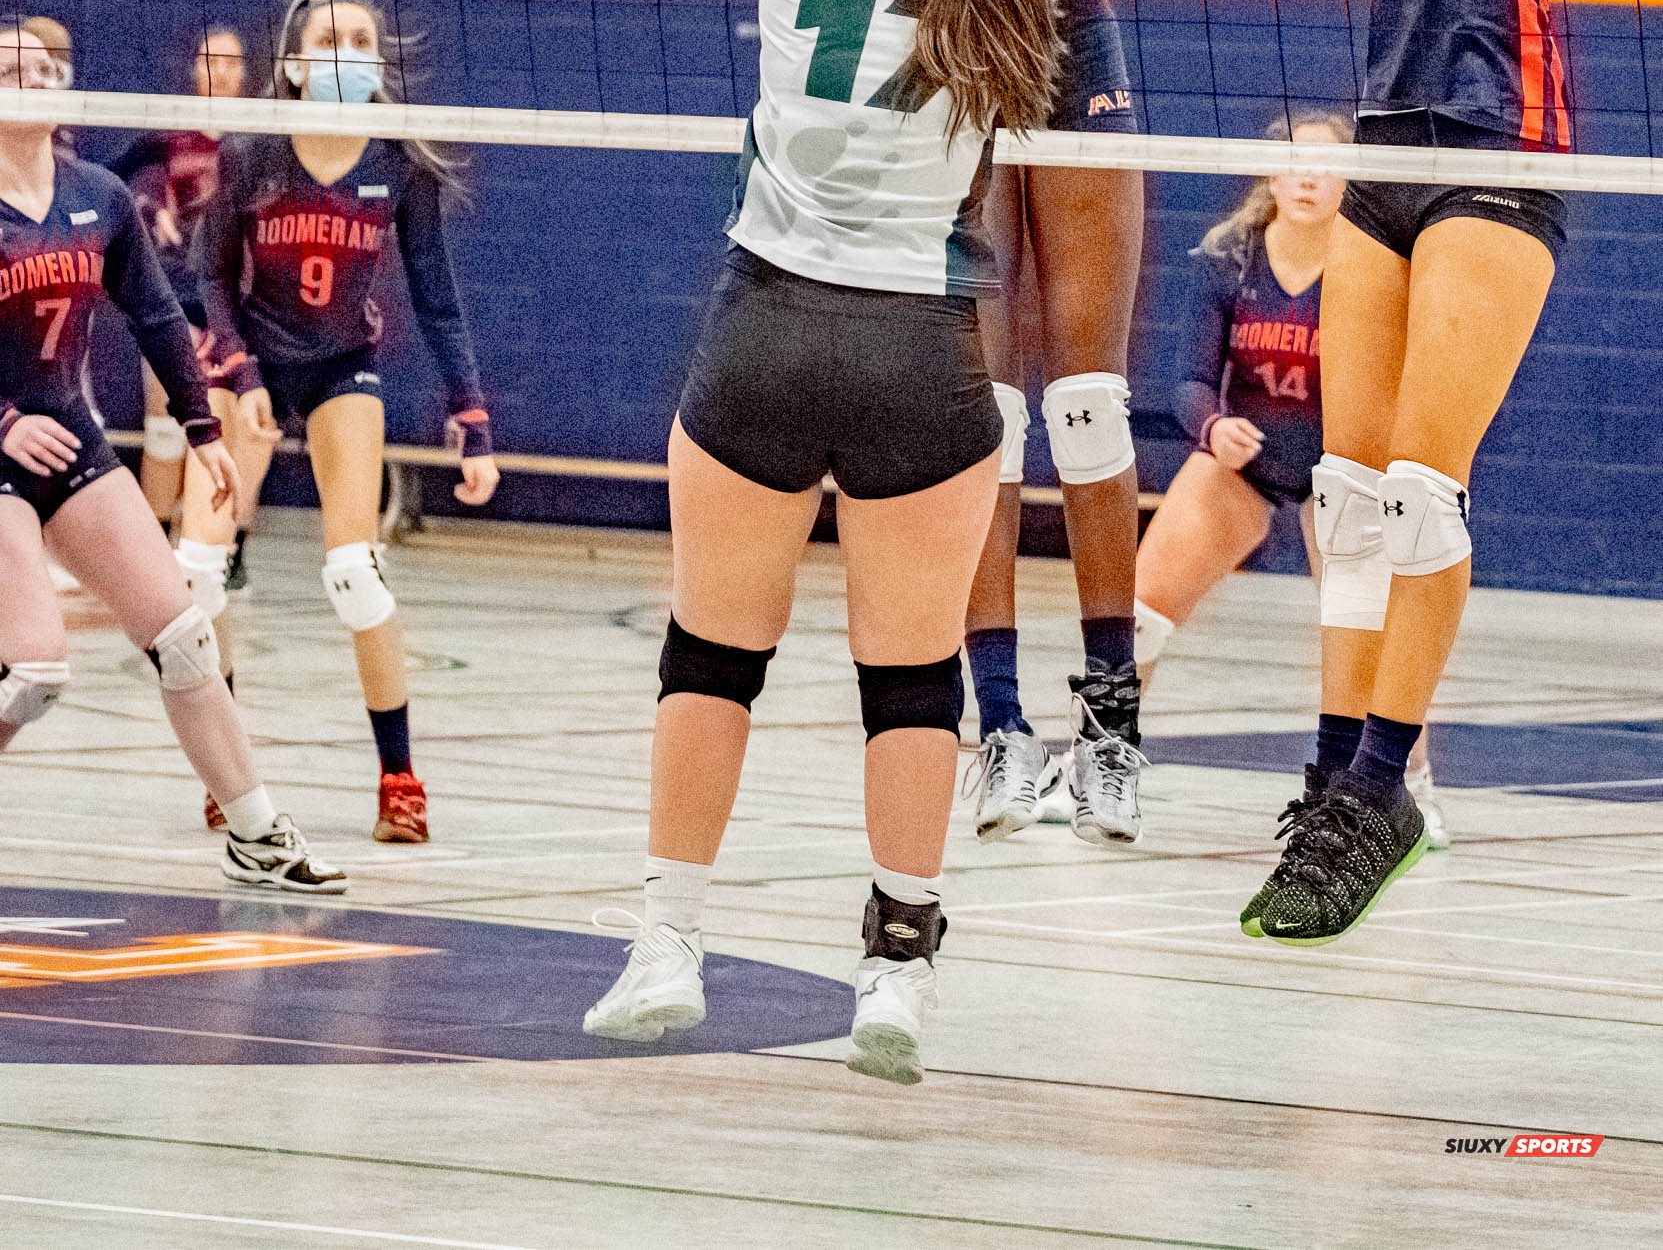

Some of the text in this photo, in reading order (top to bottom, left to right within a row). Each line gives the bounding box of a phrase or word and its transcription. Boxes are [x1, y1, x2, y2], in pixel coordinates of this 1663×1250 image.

[299, 255, 334, 307] 9
[35, 297, 72, 361] 7
[1253, 361, 1310, 401] 14
